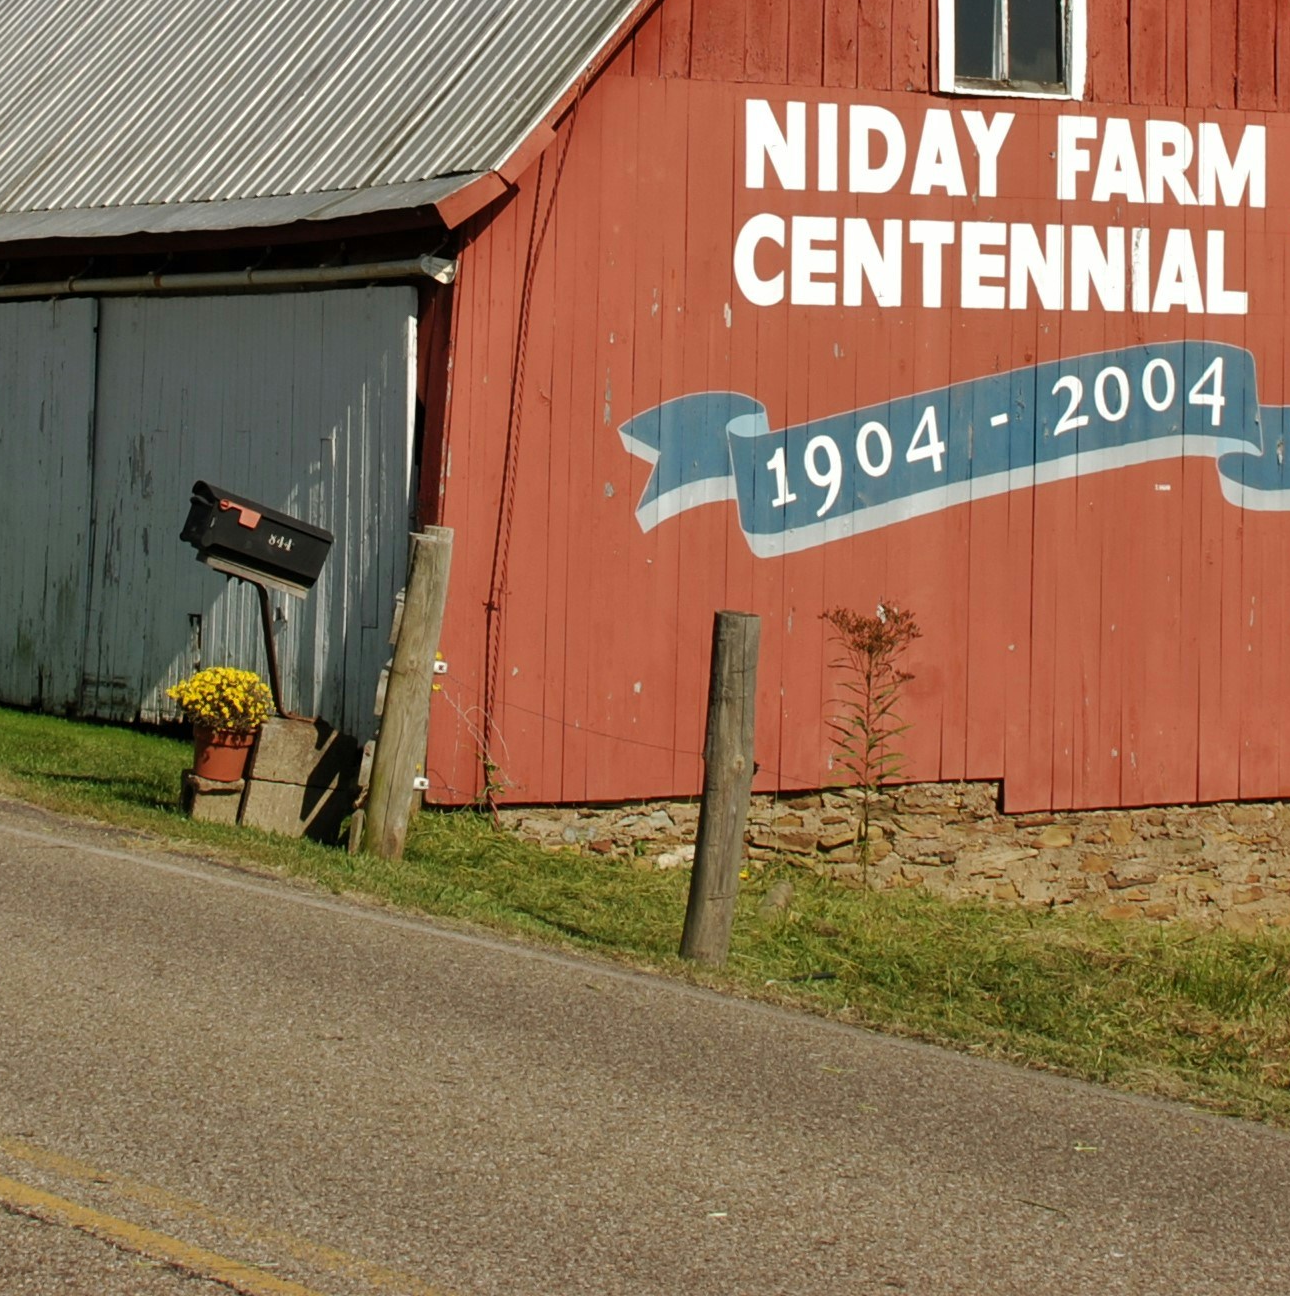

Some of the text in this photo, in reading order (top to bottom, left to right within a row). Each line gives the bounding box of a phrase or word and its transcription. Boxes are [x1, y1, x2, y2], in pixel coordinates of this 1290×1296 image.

[744, 99, 1267, 209] NIDAY FARM
[733, 212, 1249, 315] CENTENNIAL
[765, 356, 1227, 518] 1904 - 2004
[268, 534, 293, 552] 844
